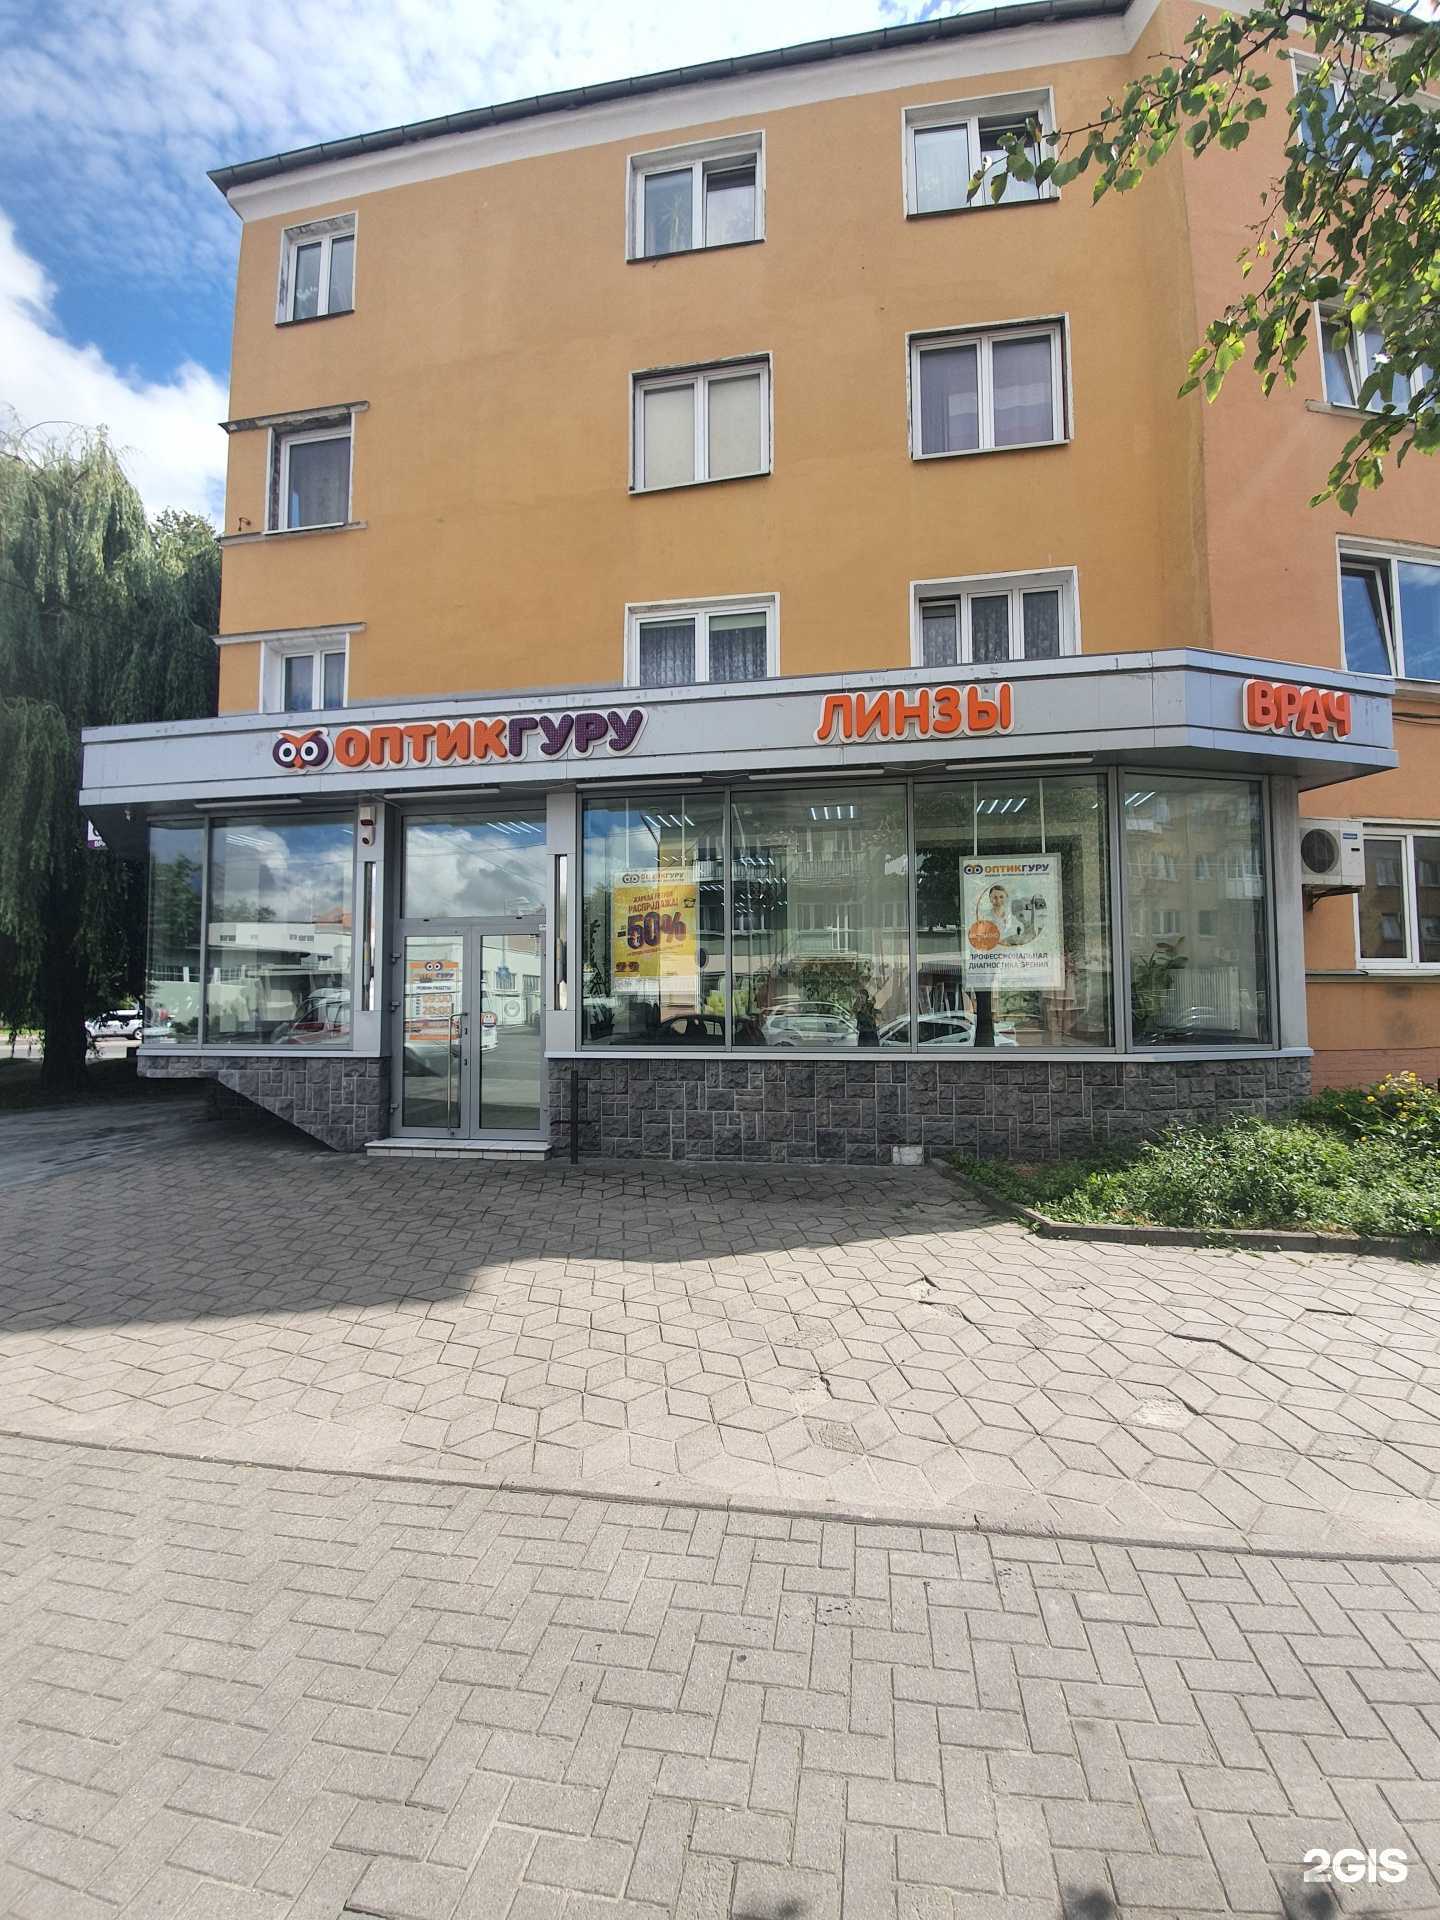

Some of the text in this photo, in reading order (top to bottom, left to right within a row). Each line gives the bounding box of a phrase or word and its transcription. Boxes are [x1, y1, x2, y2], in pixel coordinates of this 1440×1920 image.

[816, 682, 1012, 741] ЛИНЗЫ
[1246, 680, 1350, 738] ВРАЧ
[334, 709, 644, 768] ОПТИКГУРУ
[984, 863, 1050, 874] ОПТИКГУРУ
